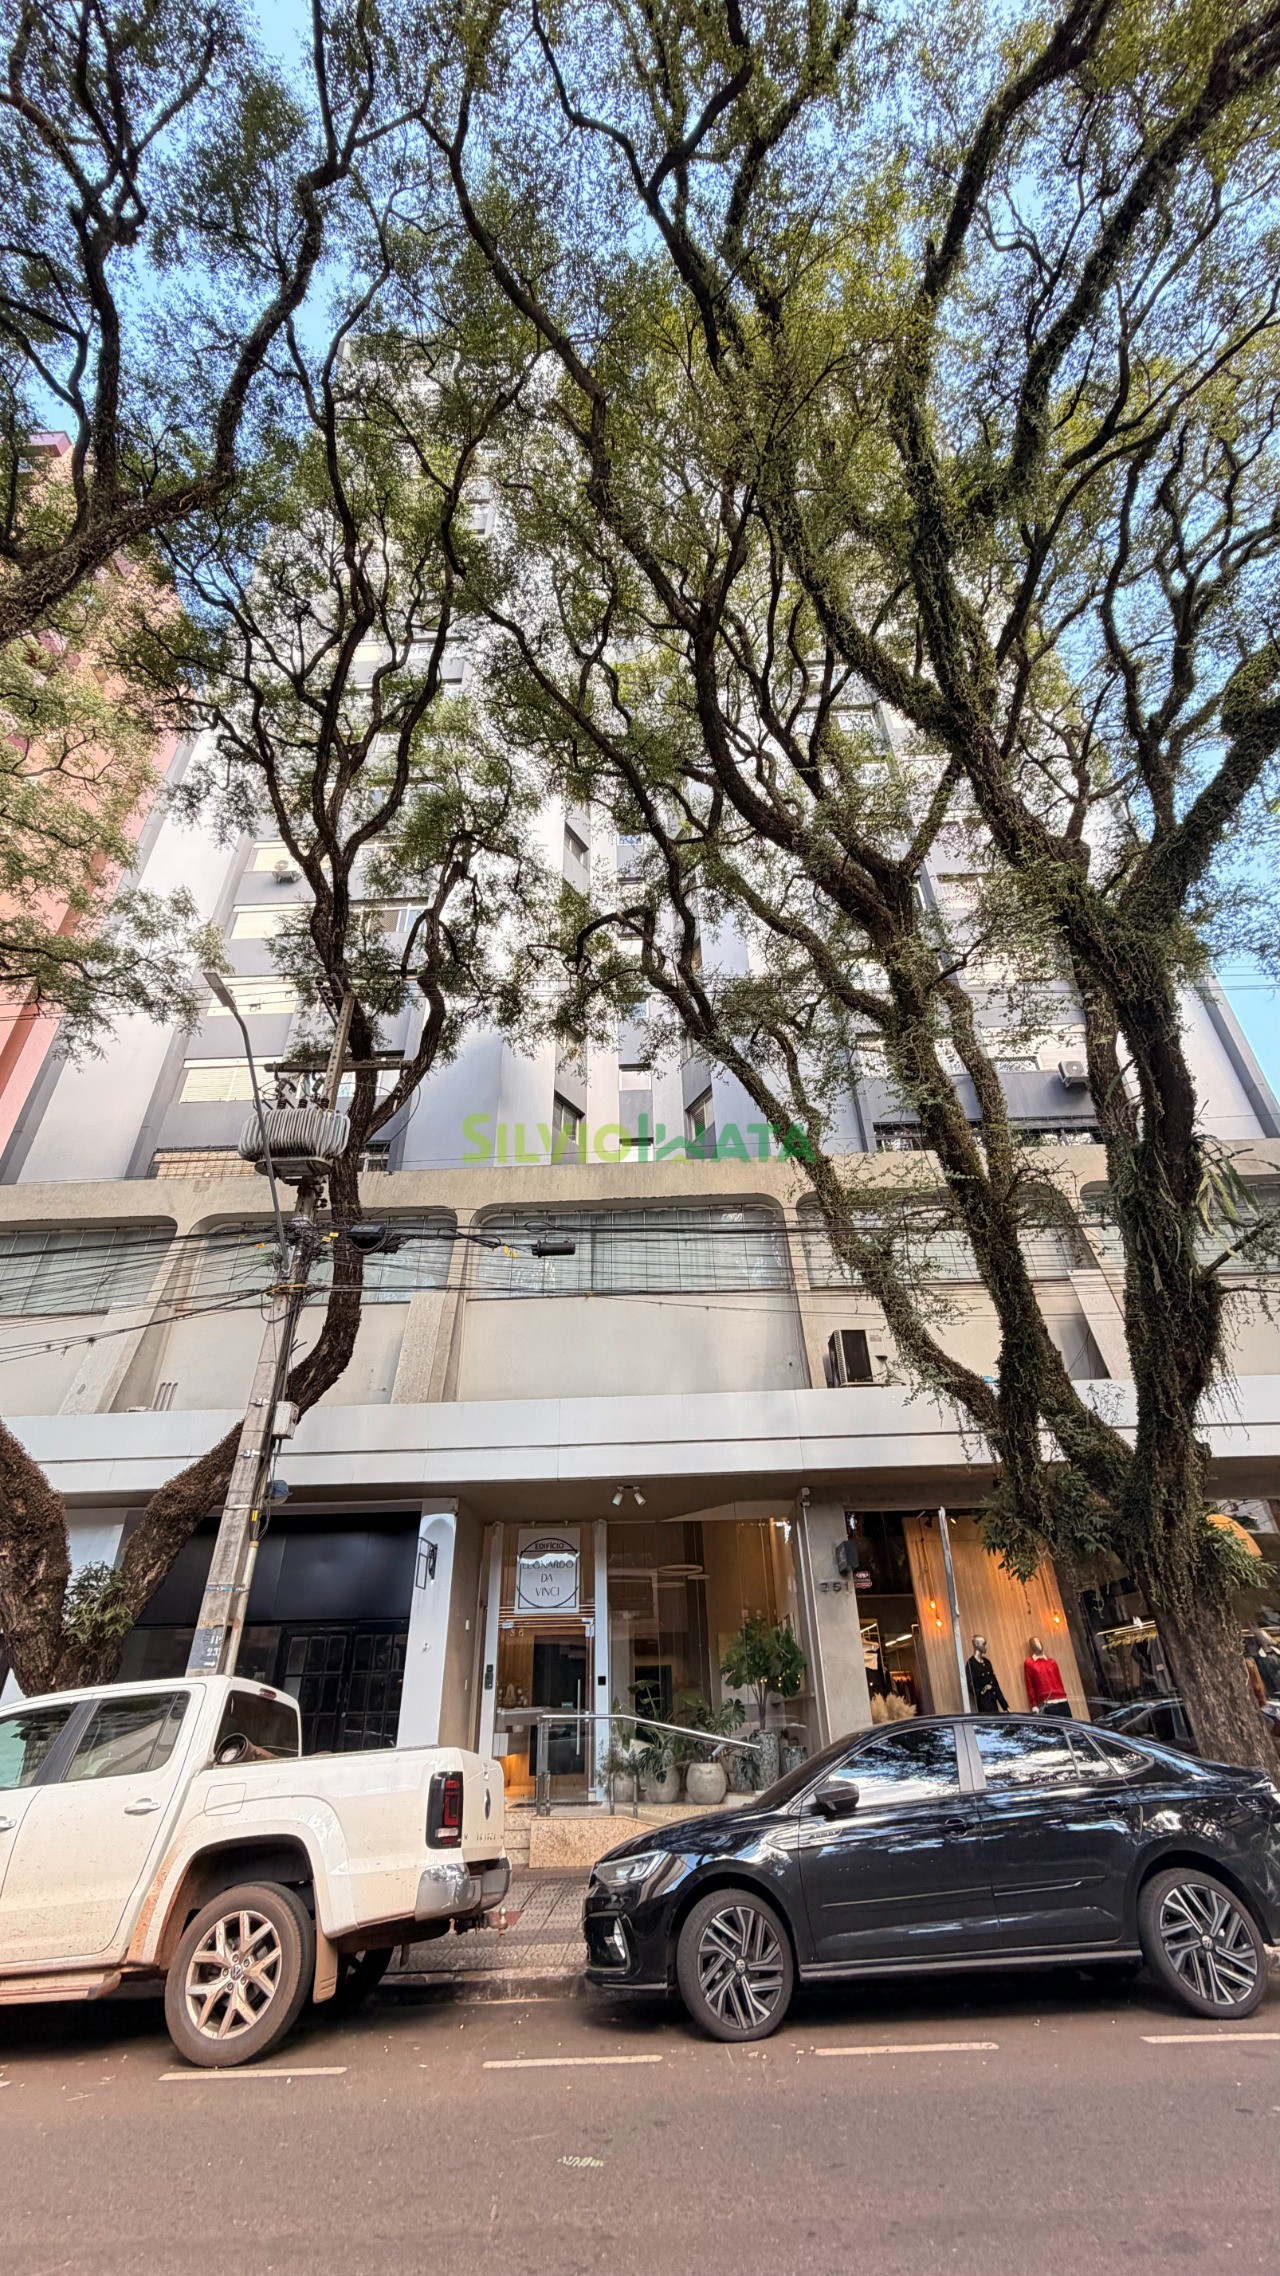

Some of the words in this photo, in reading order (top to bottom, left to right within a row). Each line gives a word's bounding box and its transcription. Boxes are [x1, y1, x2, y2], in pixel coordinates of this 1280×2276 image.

[534, 1541, 564, 1549] EDIFÍCIO
[522, 1560, 574, 1569] LEONARDO
[541, 1573, 553, 1582] DA
[535, 1586, 560, 1596] VINCI
